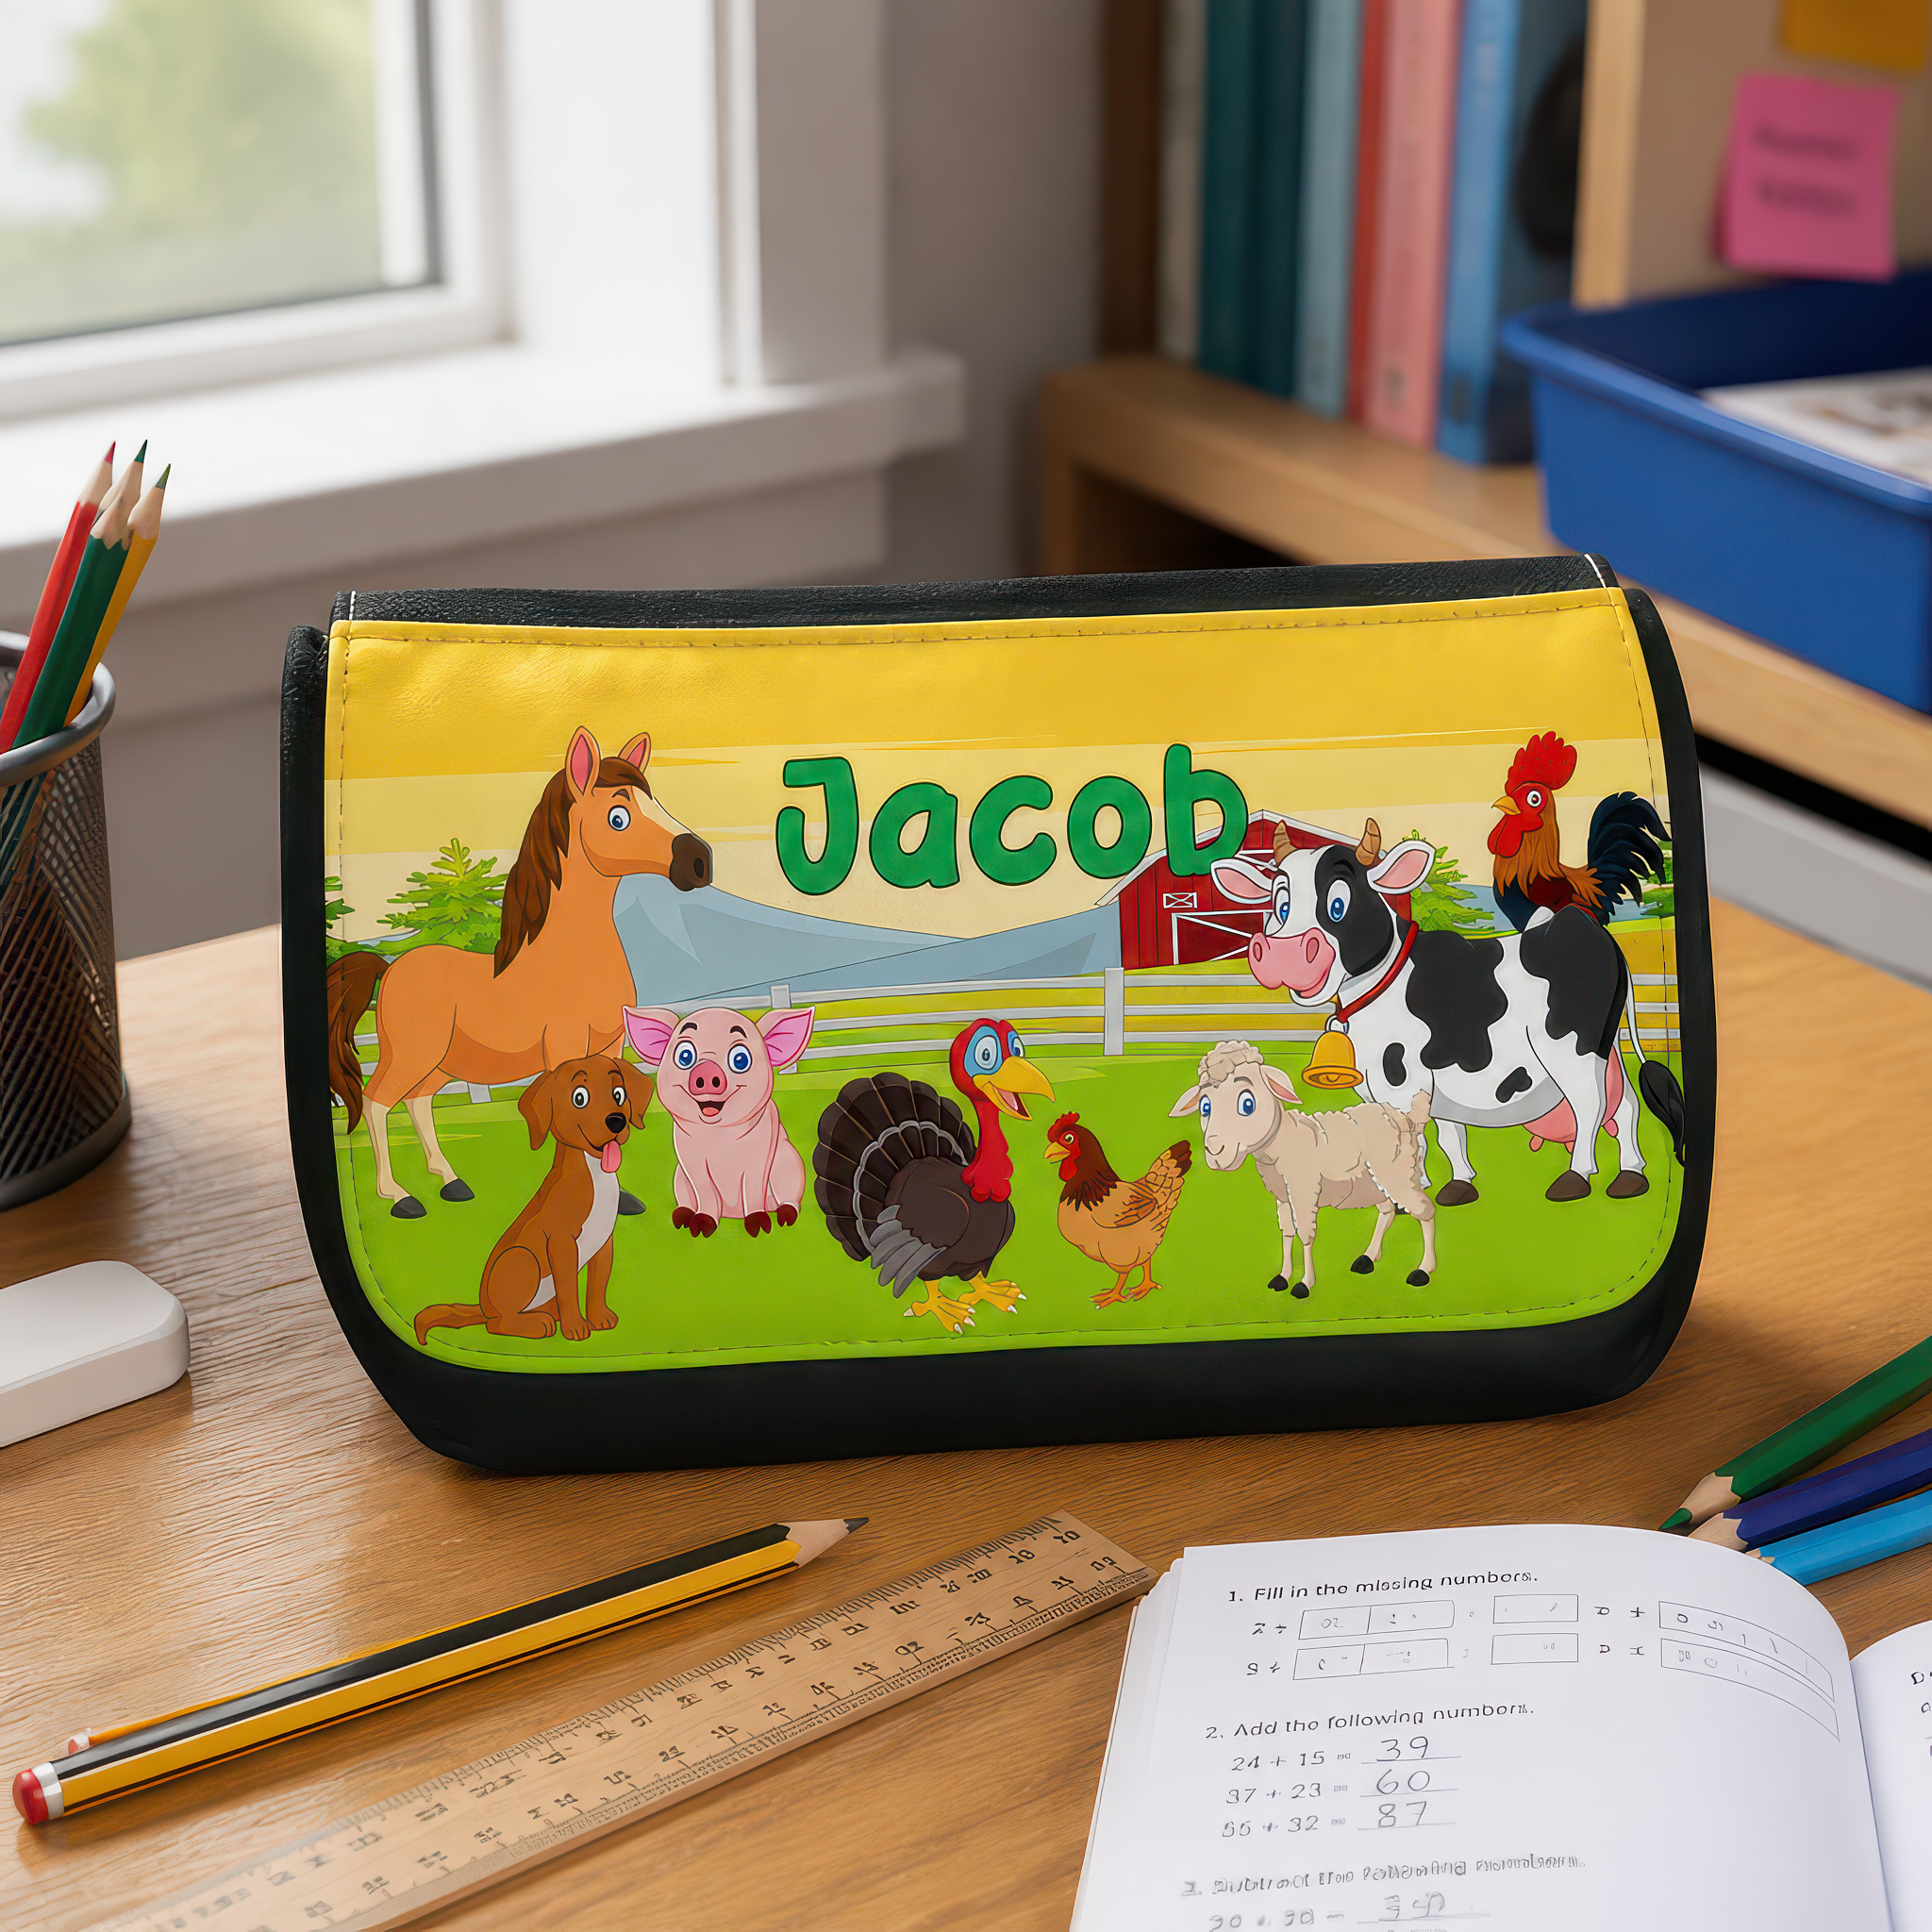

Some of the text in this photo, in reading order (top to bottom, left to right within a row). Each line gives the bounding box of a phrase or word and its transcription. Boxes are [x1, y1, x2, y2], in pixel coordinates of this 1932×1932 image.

[775, 743, 1249, 895] Jacob
[1291, 1585, 1308, 1598] in
[1234, 1721, 1277, 1736] Add
[1380, 1736, 1429, 1759] 39
[1300, 1750, 1324, 1766] 15
[1291, 1782, 1322, 1799] 23
[1376, 1769, 1430, 1795] 60
[1377, 1800, 1427, 1828] 87
[1288, 1815, 1319, 1833] 32
